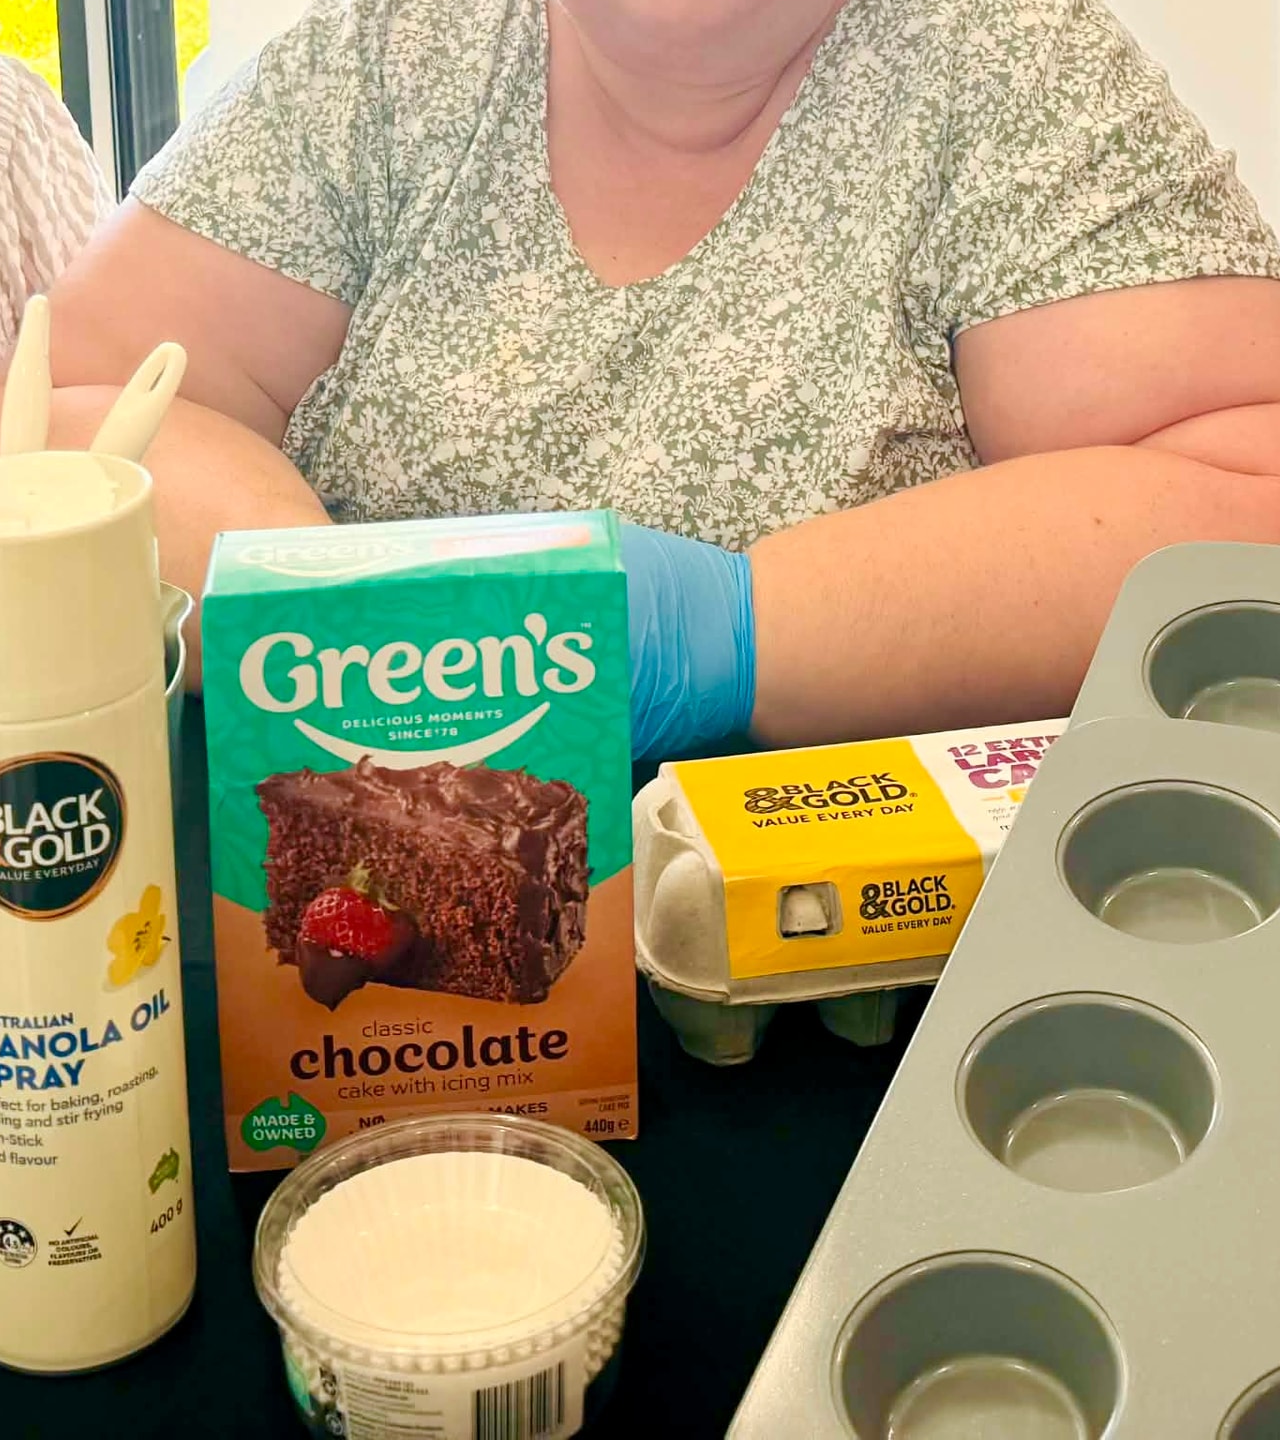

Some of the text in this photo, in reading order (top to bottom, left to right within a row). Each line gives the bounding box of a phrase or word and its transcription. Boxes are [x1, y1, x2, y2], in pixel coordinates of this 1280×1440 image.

[239, 613, 596, 713] Green's
[342, 709, 503, 730] DELICIOUS MOMENTS
[947, 744, 982, 758] 12
[954, 749, 1047, 770] LAR
[781, 772, 900, 795] BLACK
[752, 803, 914, 829] VALUE EVERY DAY
[35, 858, 100, 879] EVERYDAY
[882, 874, 948, 898] BLACK
[862, 916, 953, 935] VALUE EVERY DAY
[130, 988, 171, 1032] OIL
[362, 1018, 433, 1038] classic
[289, 1025, 569, 1080] chocolate
[26, 1100, 46, 1112] for
[50, 1092, 104, 1111] baking,
[107, 1066, 159, 1099] roasting,
[337, 1067, 534, 1099] cake with icing mix
[25, 1114, 52, 1128] and
[56, 1112, 79, 1126] stir
[84, 1100, 124, 1122] frying
[252, 1113, 316, 1128] MADE &
[252, 1127, 317, 1142] OWNED
[583, 1118, 615, 1133] 440g
[10, 1152, 58, 1166] flavour
[150, 1206, 174, 1234] 400
